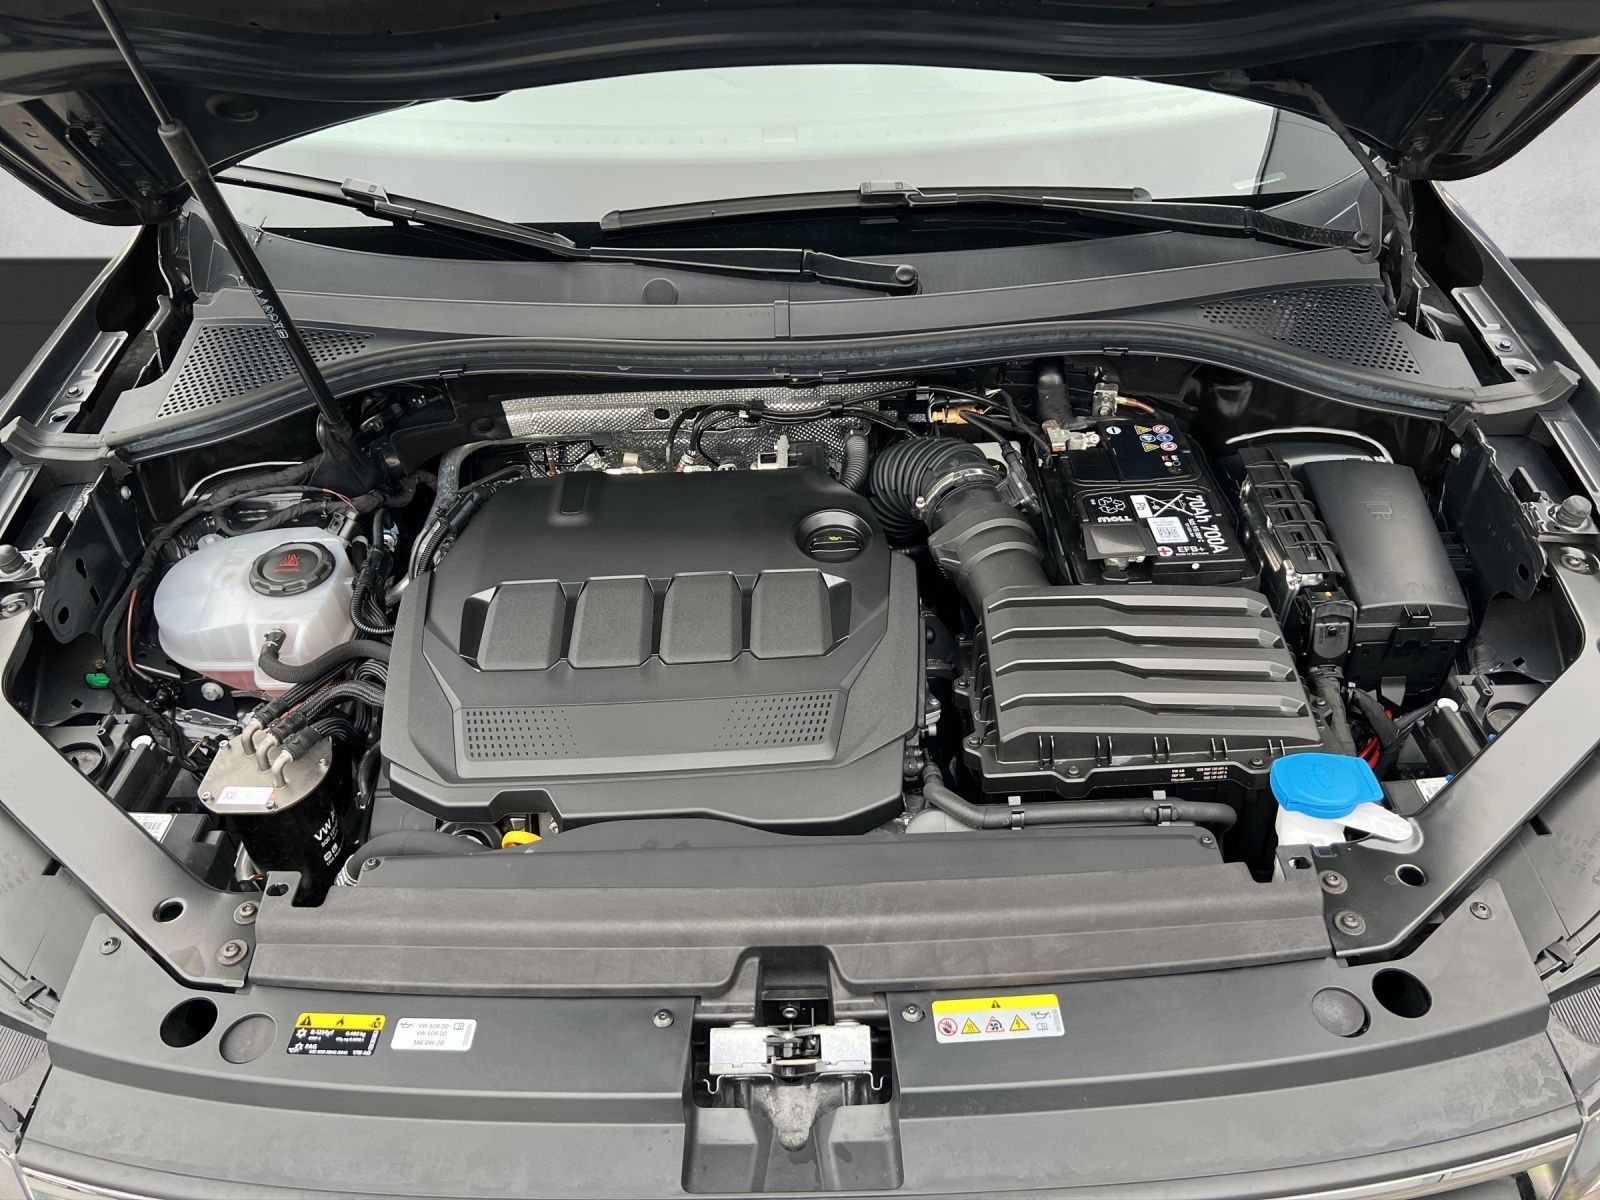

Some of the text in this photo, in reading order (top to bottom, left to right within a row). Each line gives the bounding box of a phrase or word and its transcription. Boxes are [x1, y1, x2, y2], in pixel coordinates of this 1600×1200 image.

[1135, 502, 1147, 510] Pb
[1186, 495, 1212, 522] 70Ah
[1199, 524, 1229, 554] 700A
[1176, 545, 1205, 553] EFB+
[314, 818, 332, 841] VW
